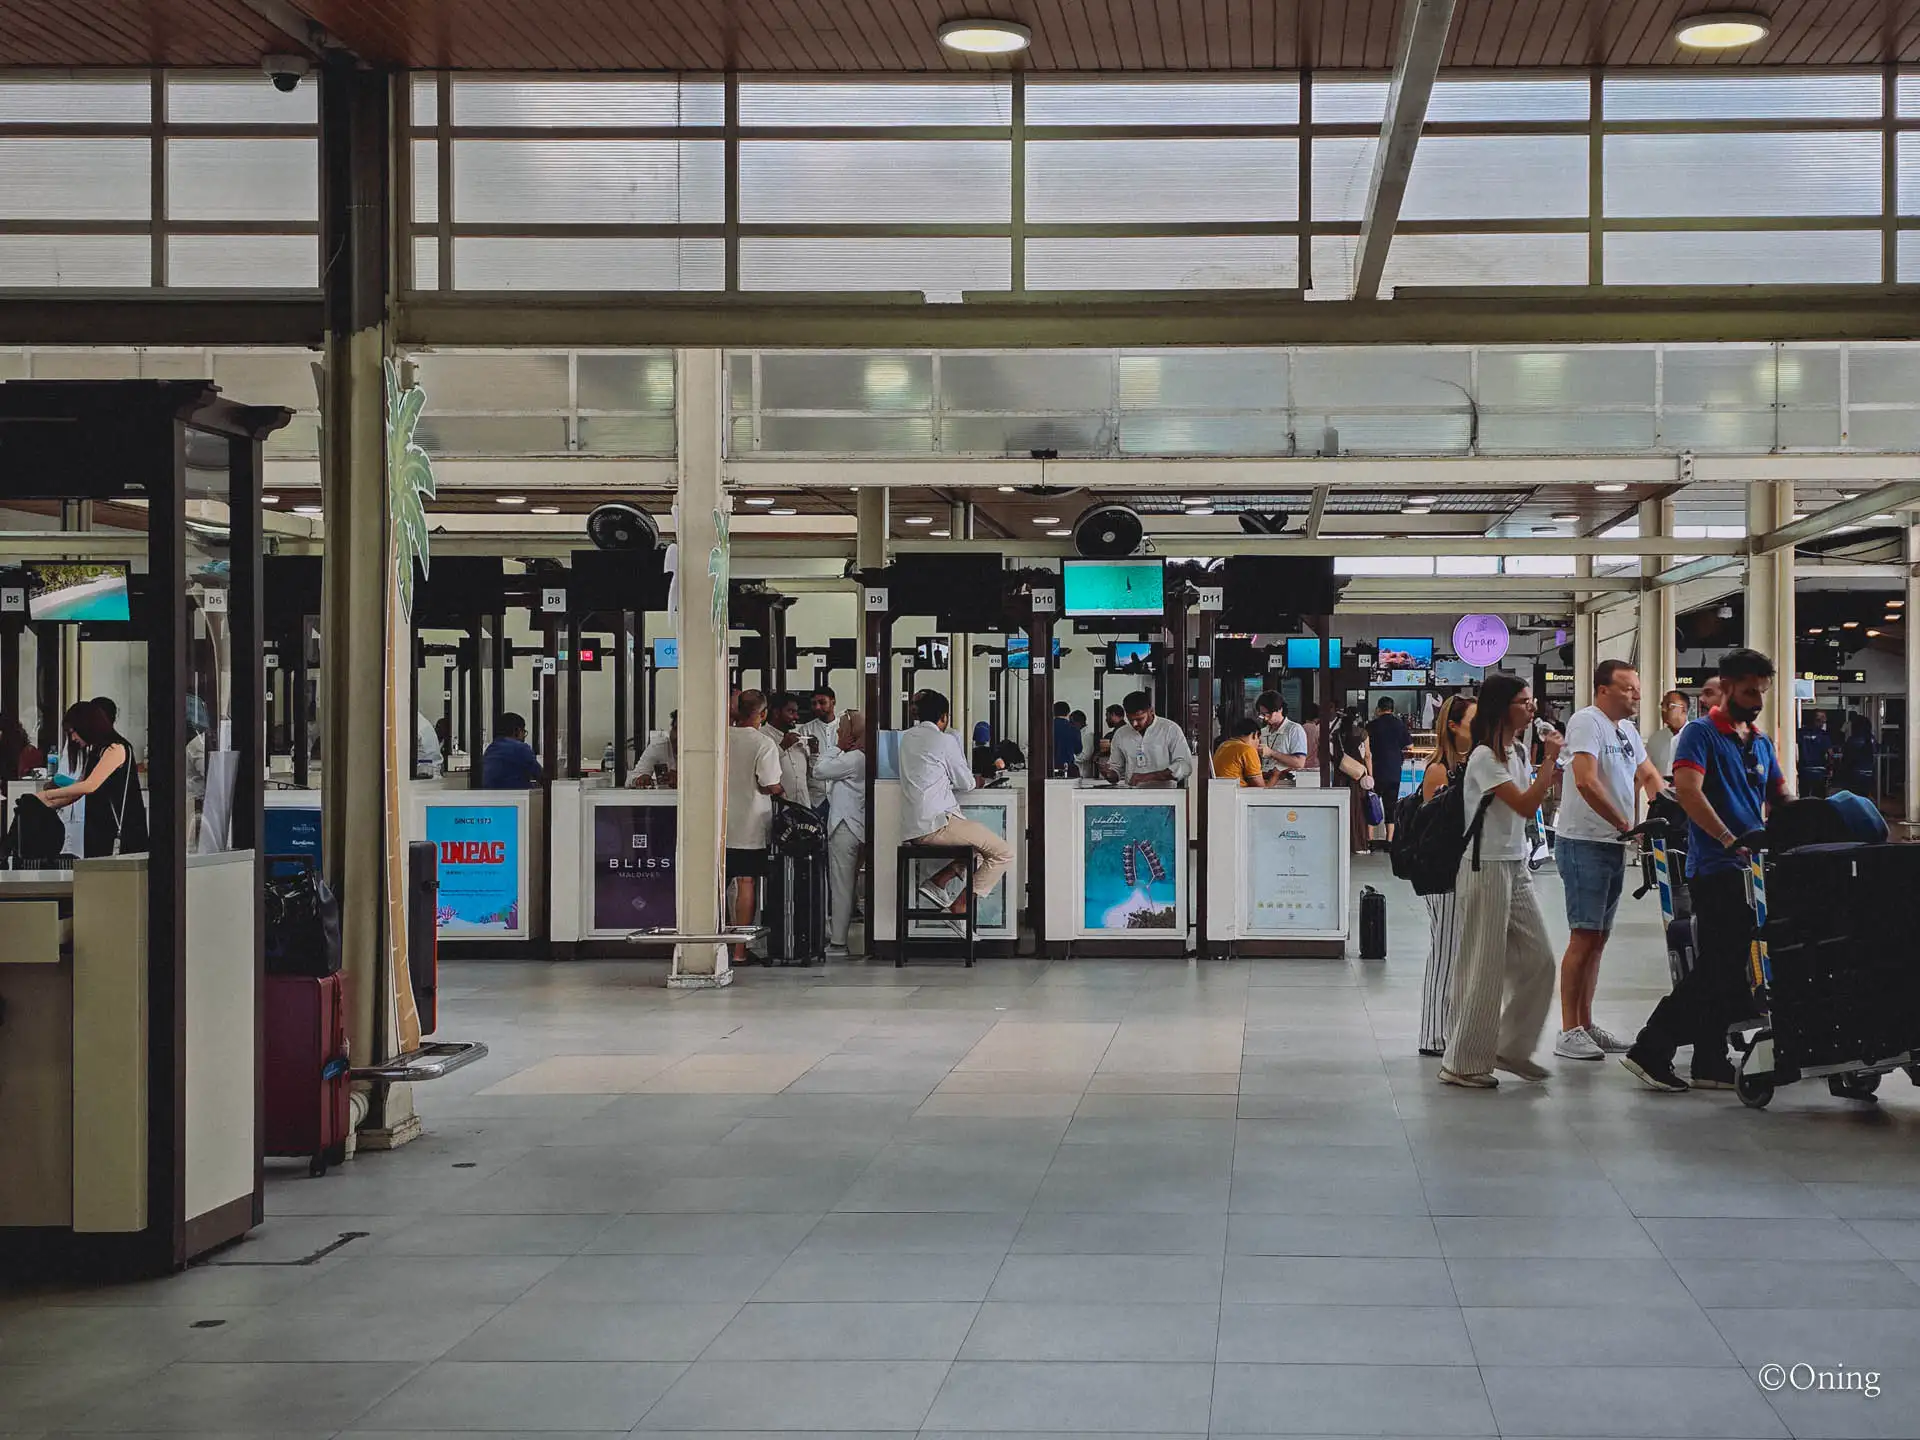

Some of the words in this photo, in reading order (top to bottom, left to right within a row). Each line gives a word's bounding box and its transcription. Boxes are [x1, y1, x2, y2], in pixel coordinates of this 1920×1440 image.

[6, 595, 20, 604] D5
[209, 596, 222, 605] D6
[547, 596, 561, 605] D8
[870, 595, 883, 604] D9
[1035, 595, 1053, 604] D10
[1202, 594, 1221, 603] D11
[1464, 631, 1498, 653] Grape
[440, 841, 505, 865] INPAC
[609, 858, 671, 868] BLISS
[617, 871, 662, 879] MALDIVES
